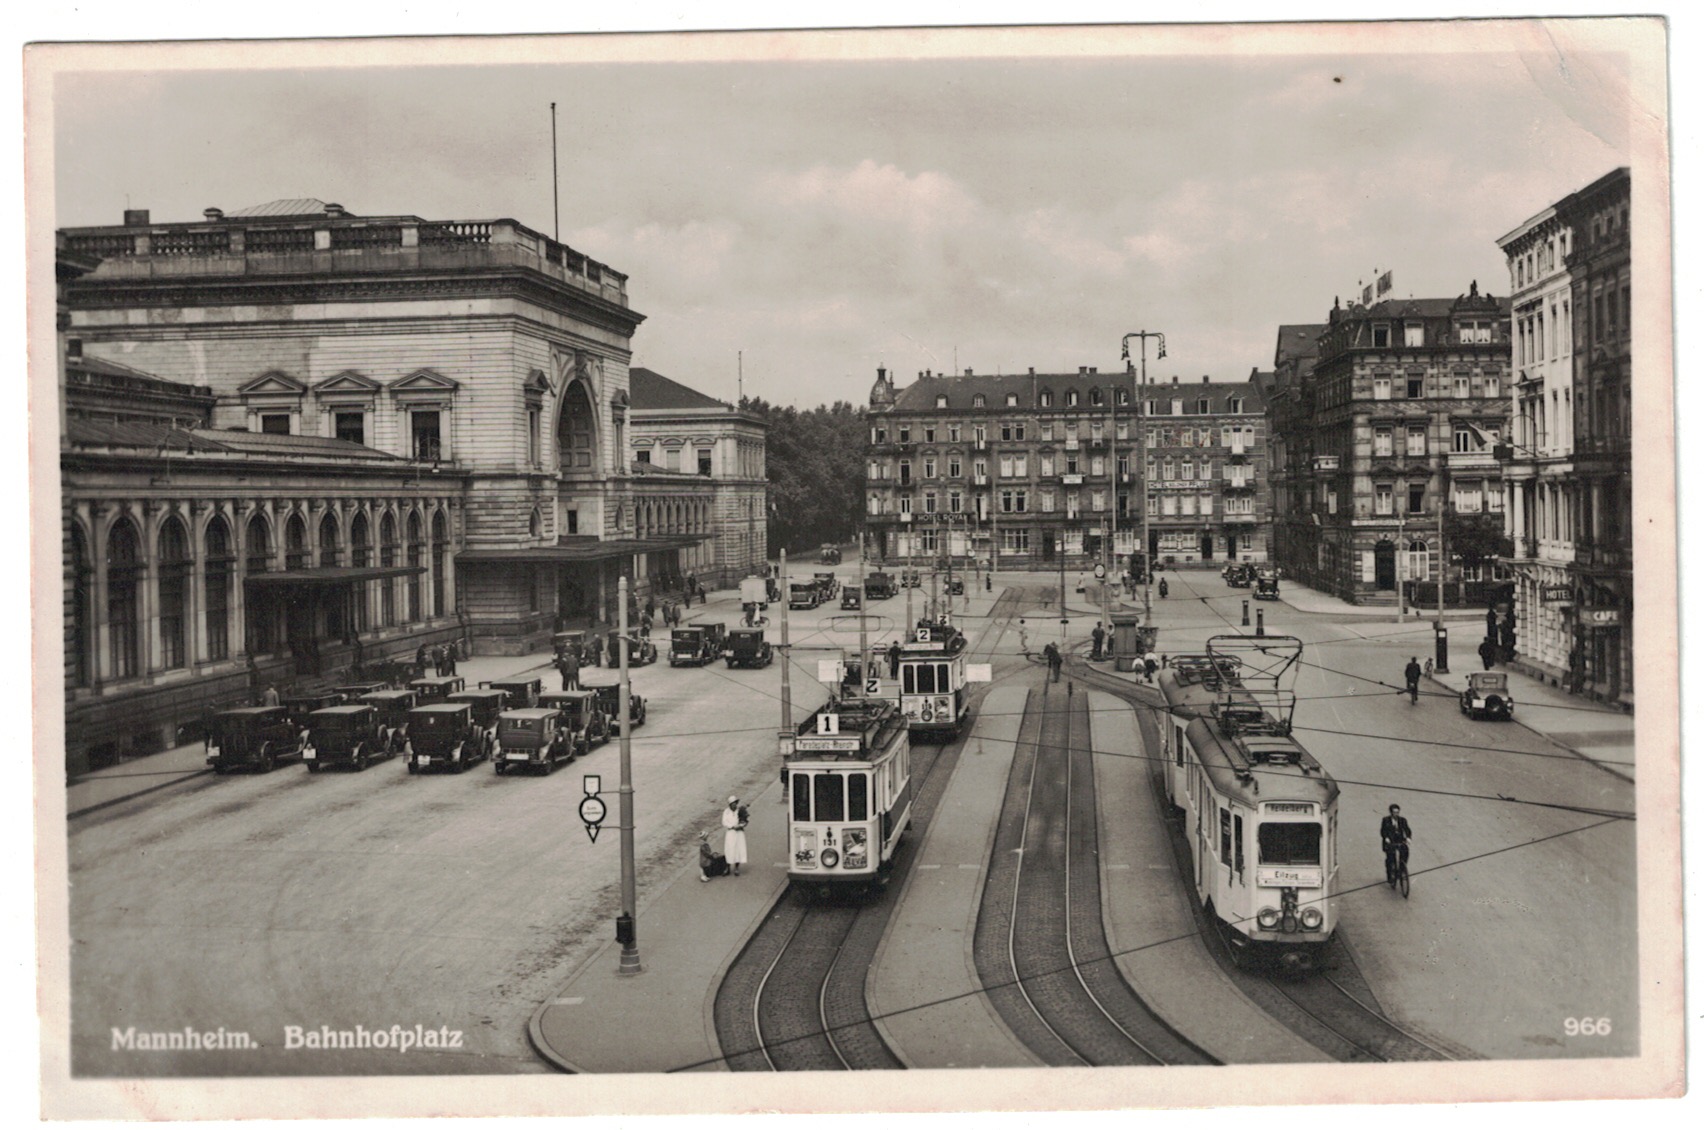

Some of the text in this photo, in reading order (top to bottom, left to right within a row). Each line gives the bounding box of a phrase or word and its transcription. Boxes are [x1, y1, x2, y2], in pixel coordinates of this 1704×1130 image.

[917, 513, 942, 522] HOTEL
[1545, 589, 1572, 600] HOTEL
[919, 628, 929, 641] 2
[823, 715, 831, 732] 1
[822, 838, 837, 847] 131
[1274, 870, 1299, 880] Eilzug
